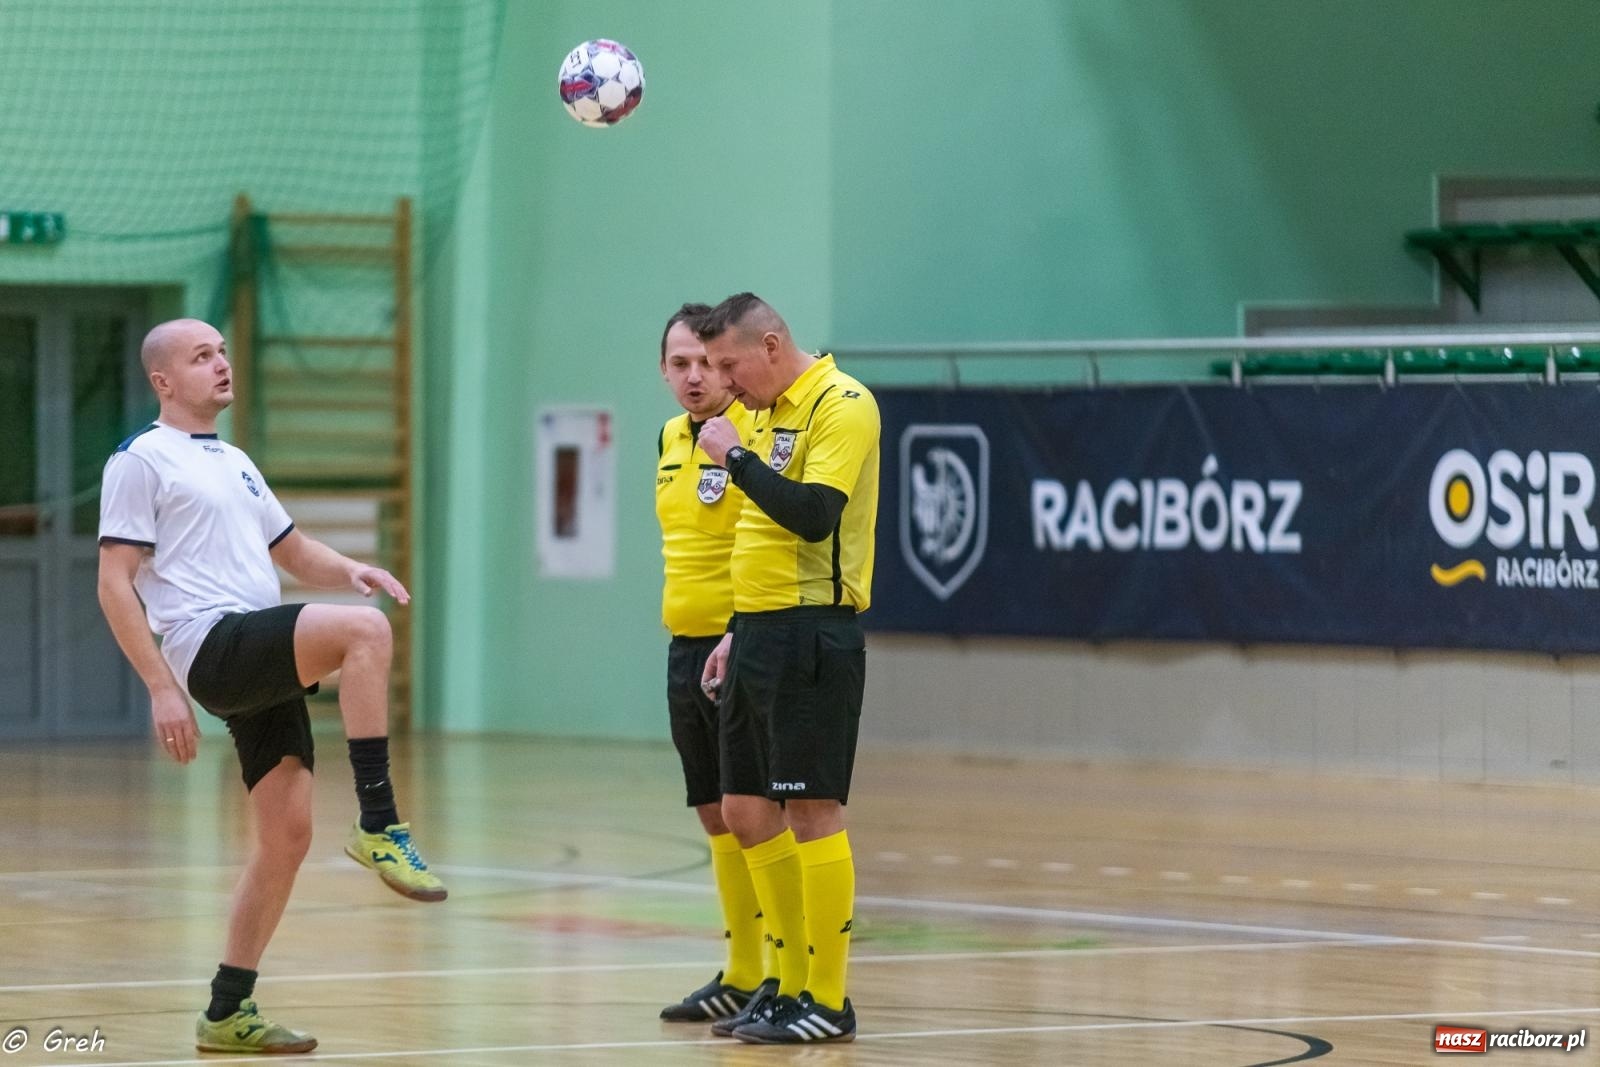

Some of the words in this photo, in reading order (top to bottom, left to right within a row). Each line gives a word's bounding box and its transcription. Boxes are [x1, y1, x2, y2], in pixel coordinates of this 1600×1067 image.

[1031, 453, 1302, 553] RACIBÓRZ
[1429, 448, 1599, 551] OSiR
[1496, 550, 1600, 588] RACIBÓRZ
[772, 782, 806, 791] zina
